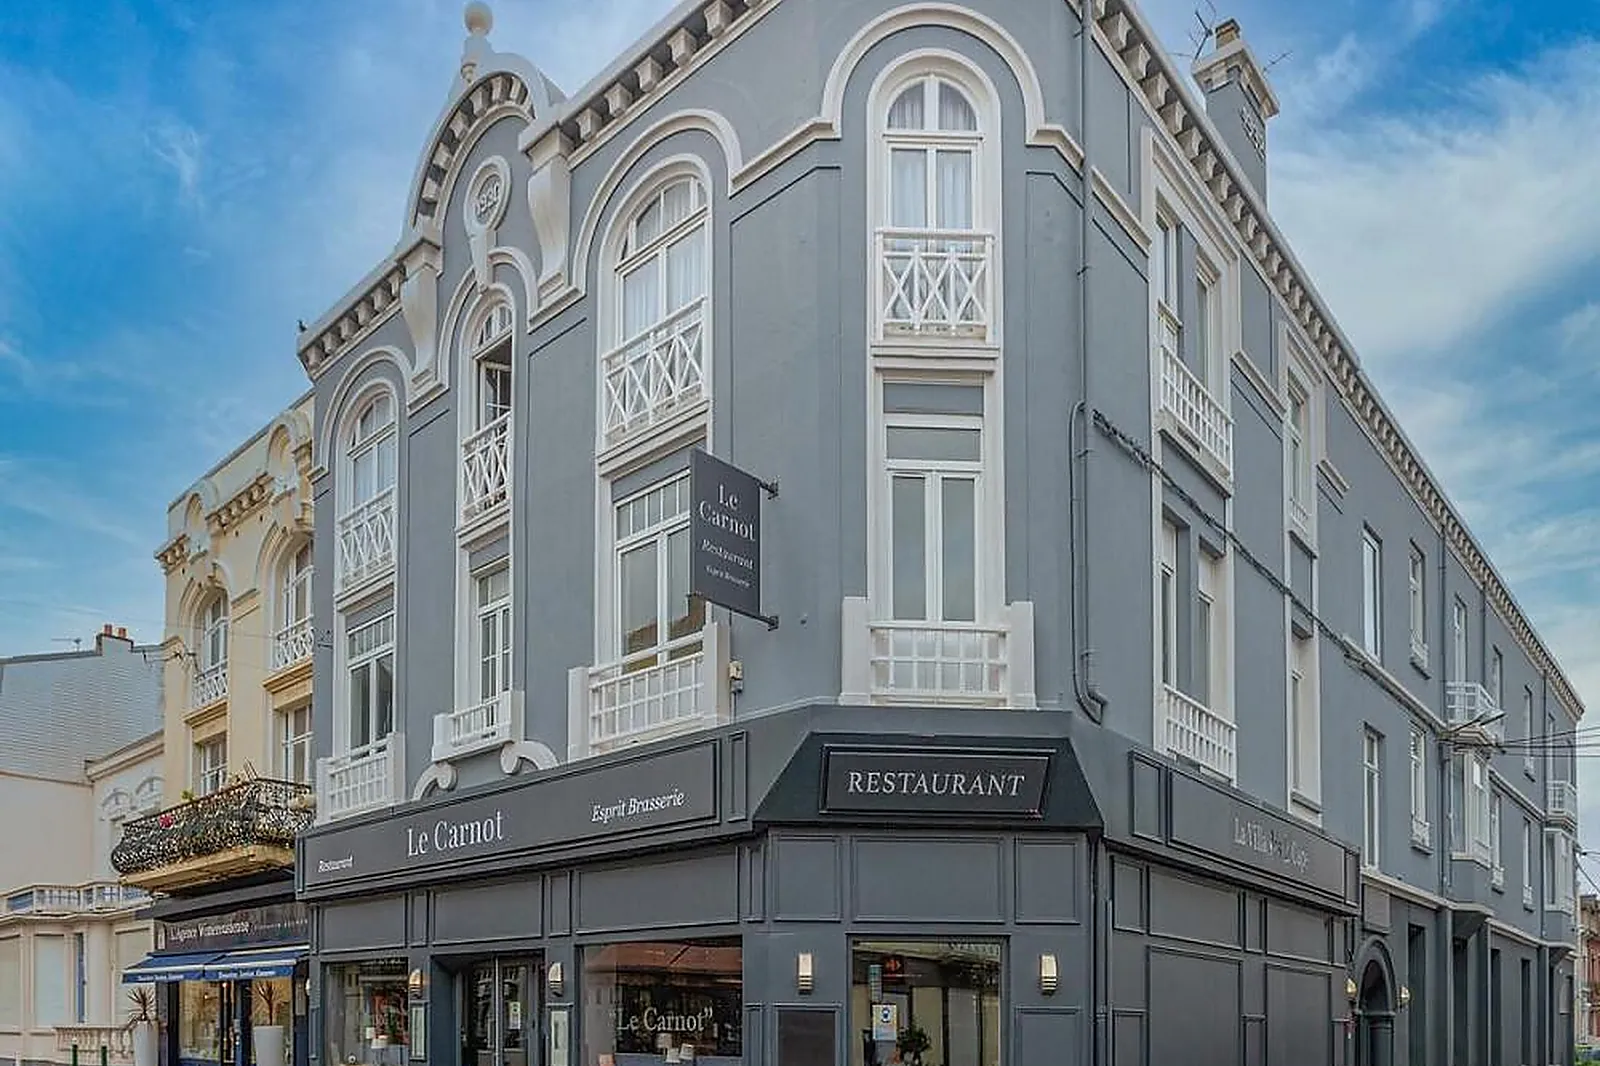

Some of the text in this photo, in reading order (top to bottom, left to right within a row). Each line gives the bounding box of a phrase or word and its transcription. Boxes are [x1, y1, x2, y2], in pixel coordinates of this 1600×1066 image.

[718, 483, 739, 511] Le
[699, 500, 756, 542] Carnot
[849, 771, 1025, 796] RESTAURANT
[591, 788, 685, 824] Esprit Brasserie
[407, 810, 505, 857] Le Carnot
